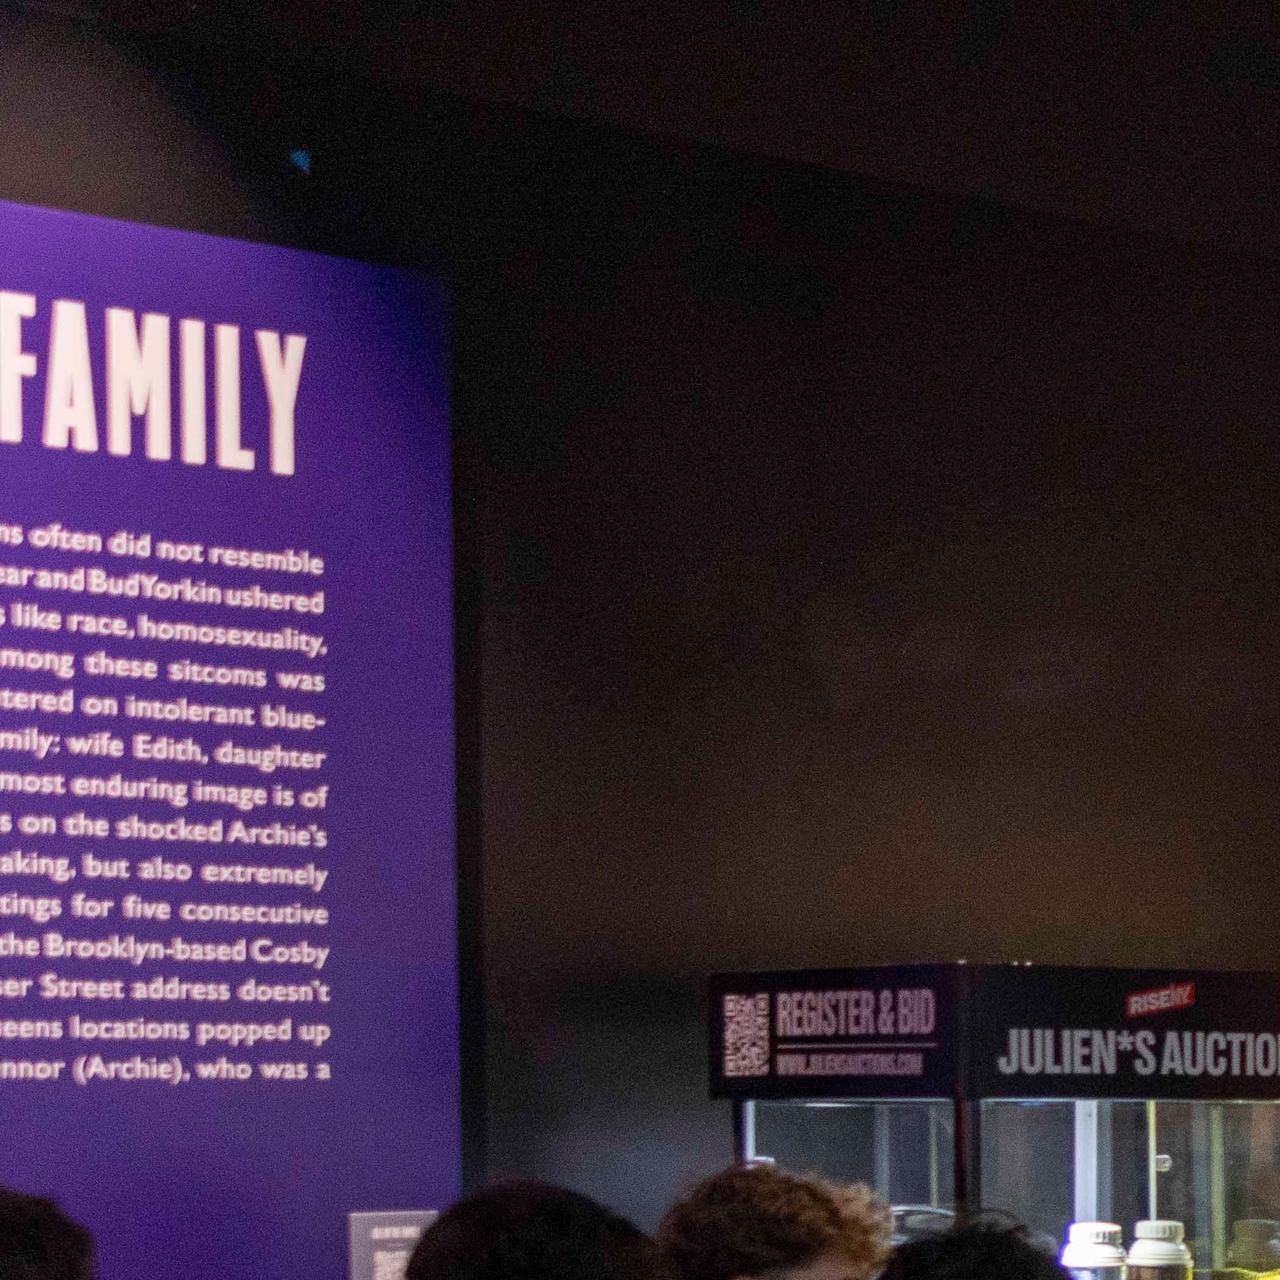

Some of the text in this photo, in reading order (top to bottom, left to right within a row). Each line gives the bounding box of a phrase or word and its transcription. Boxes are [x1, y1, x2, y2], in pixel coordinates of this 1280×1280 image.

[0, 291, 307, 476] FAMILY
[28, 523, 102, 552] often
[107, 530, 151, 558] did
[156, 541, 204, 563] not
[208, 547, 324, 575] resemble
[36, 568, 85, 592] and
[89, 570, 140, 596] Bud
[140, 574, 222, 604] Yorkin
[224, 585, 324, 613] ushered
[12, 603, 61, 630] like
[84, 651, 157, 678] these
[168, 660, 267, 686] sitcoms
[277, 673, 325, 690] was
[81, 697, 118, 715] on
[126, 696, 255, 724] intolerant
[66, 732, 124, 755] wife
[215, 741, 327, 772] daughter
[70, 774, 188, 807] enduring
[193, 780, 267, 810] image
[274, 785, 294, 804] is
[300, 785, 329, 806] of
[776, 988, 936, 1037] REGISTER & BID
